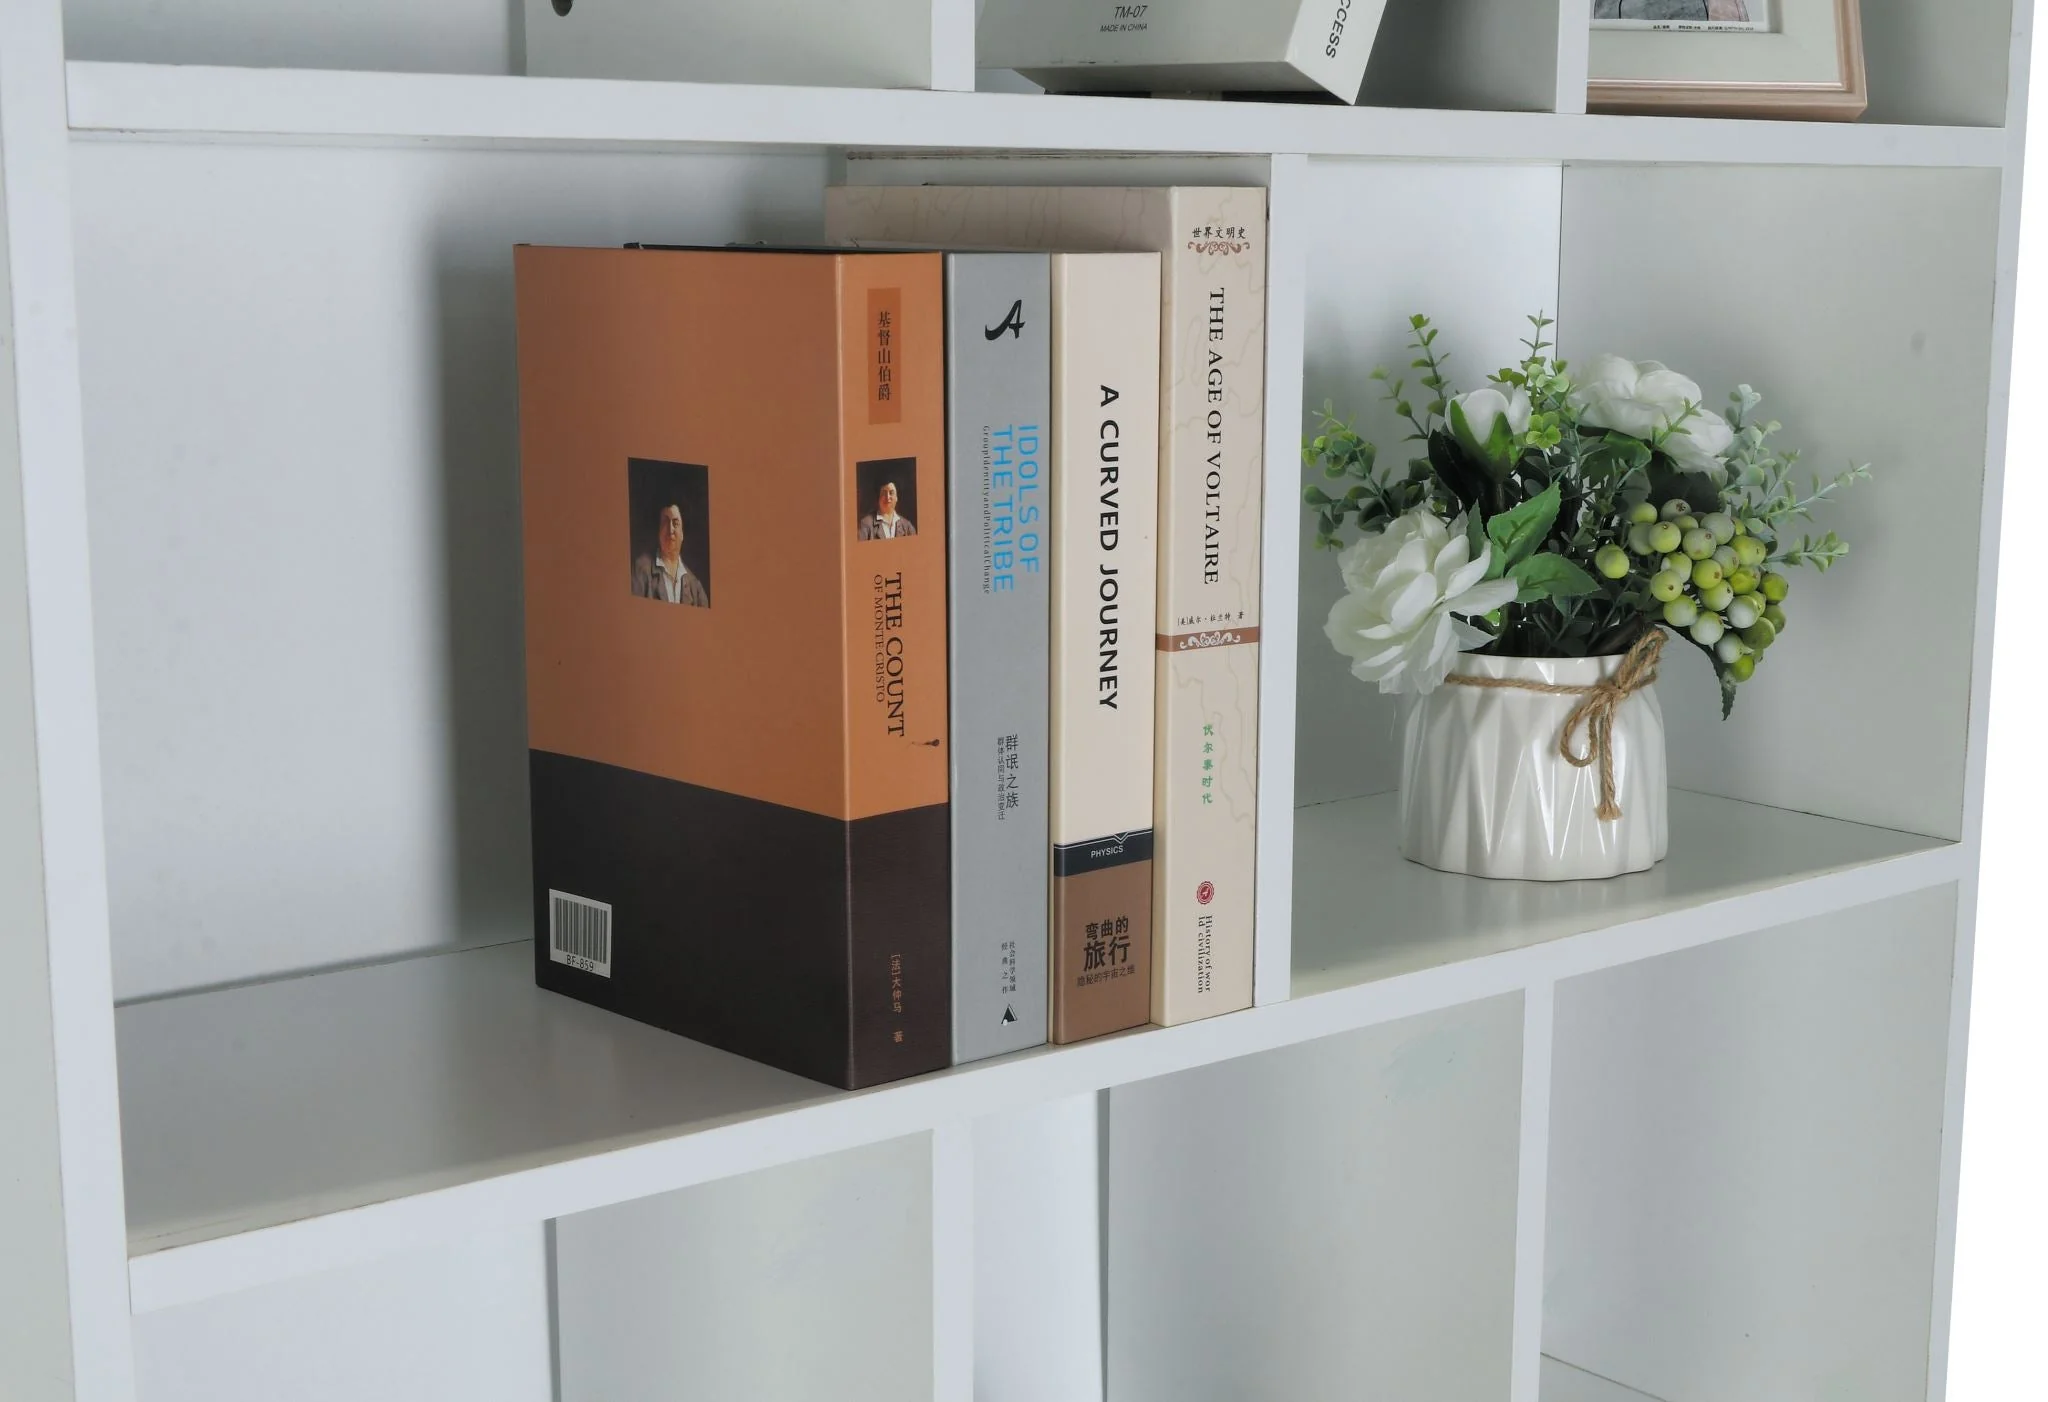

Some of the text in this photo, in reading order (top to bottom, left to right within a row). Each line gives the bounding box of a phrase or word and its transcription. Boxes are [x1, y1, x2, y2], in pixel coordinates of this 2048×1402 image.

[1100, 24, 1119, 32] MADE
[1128, 23, 1148, 31] CHINA
[1113, 5, 1147, 19] TM-07
[1192, 226, 1246, 239] 世界文明史
[877, 311, 891, 401] 基督山伯爵
[1204, 287, 1224, 585] THE AGE OF VOLTAIRE
[992, 424, 1014, 592] THE TRIBE
[1018, 424, 1040, 573] IDOLS OF
[1099, 384, 1120, 710] A CURVED JOURNEY
[873, 574, 885, 703] OF MONTE CRISTO
[885, 572, 905, 737] THE COUNT
[1005, 733, 1019, 809] 群氓之族
[1090, 845, 1124, 859] PHYSICS
[1085, 915, 1129, 940] 弯曲的
[1205, 915, 1213, 956] History
[566, 954, 594, 972] BF-859
[1083, 935, 1131, 972] 旅行
[1205, 958, 1212, 970] of
